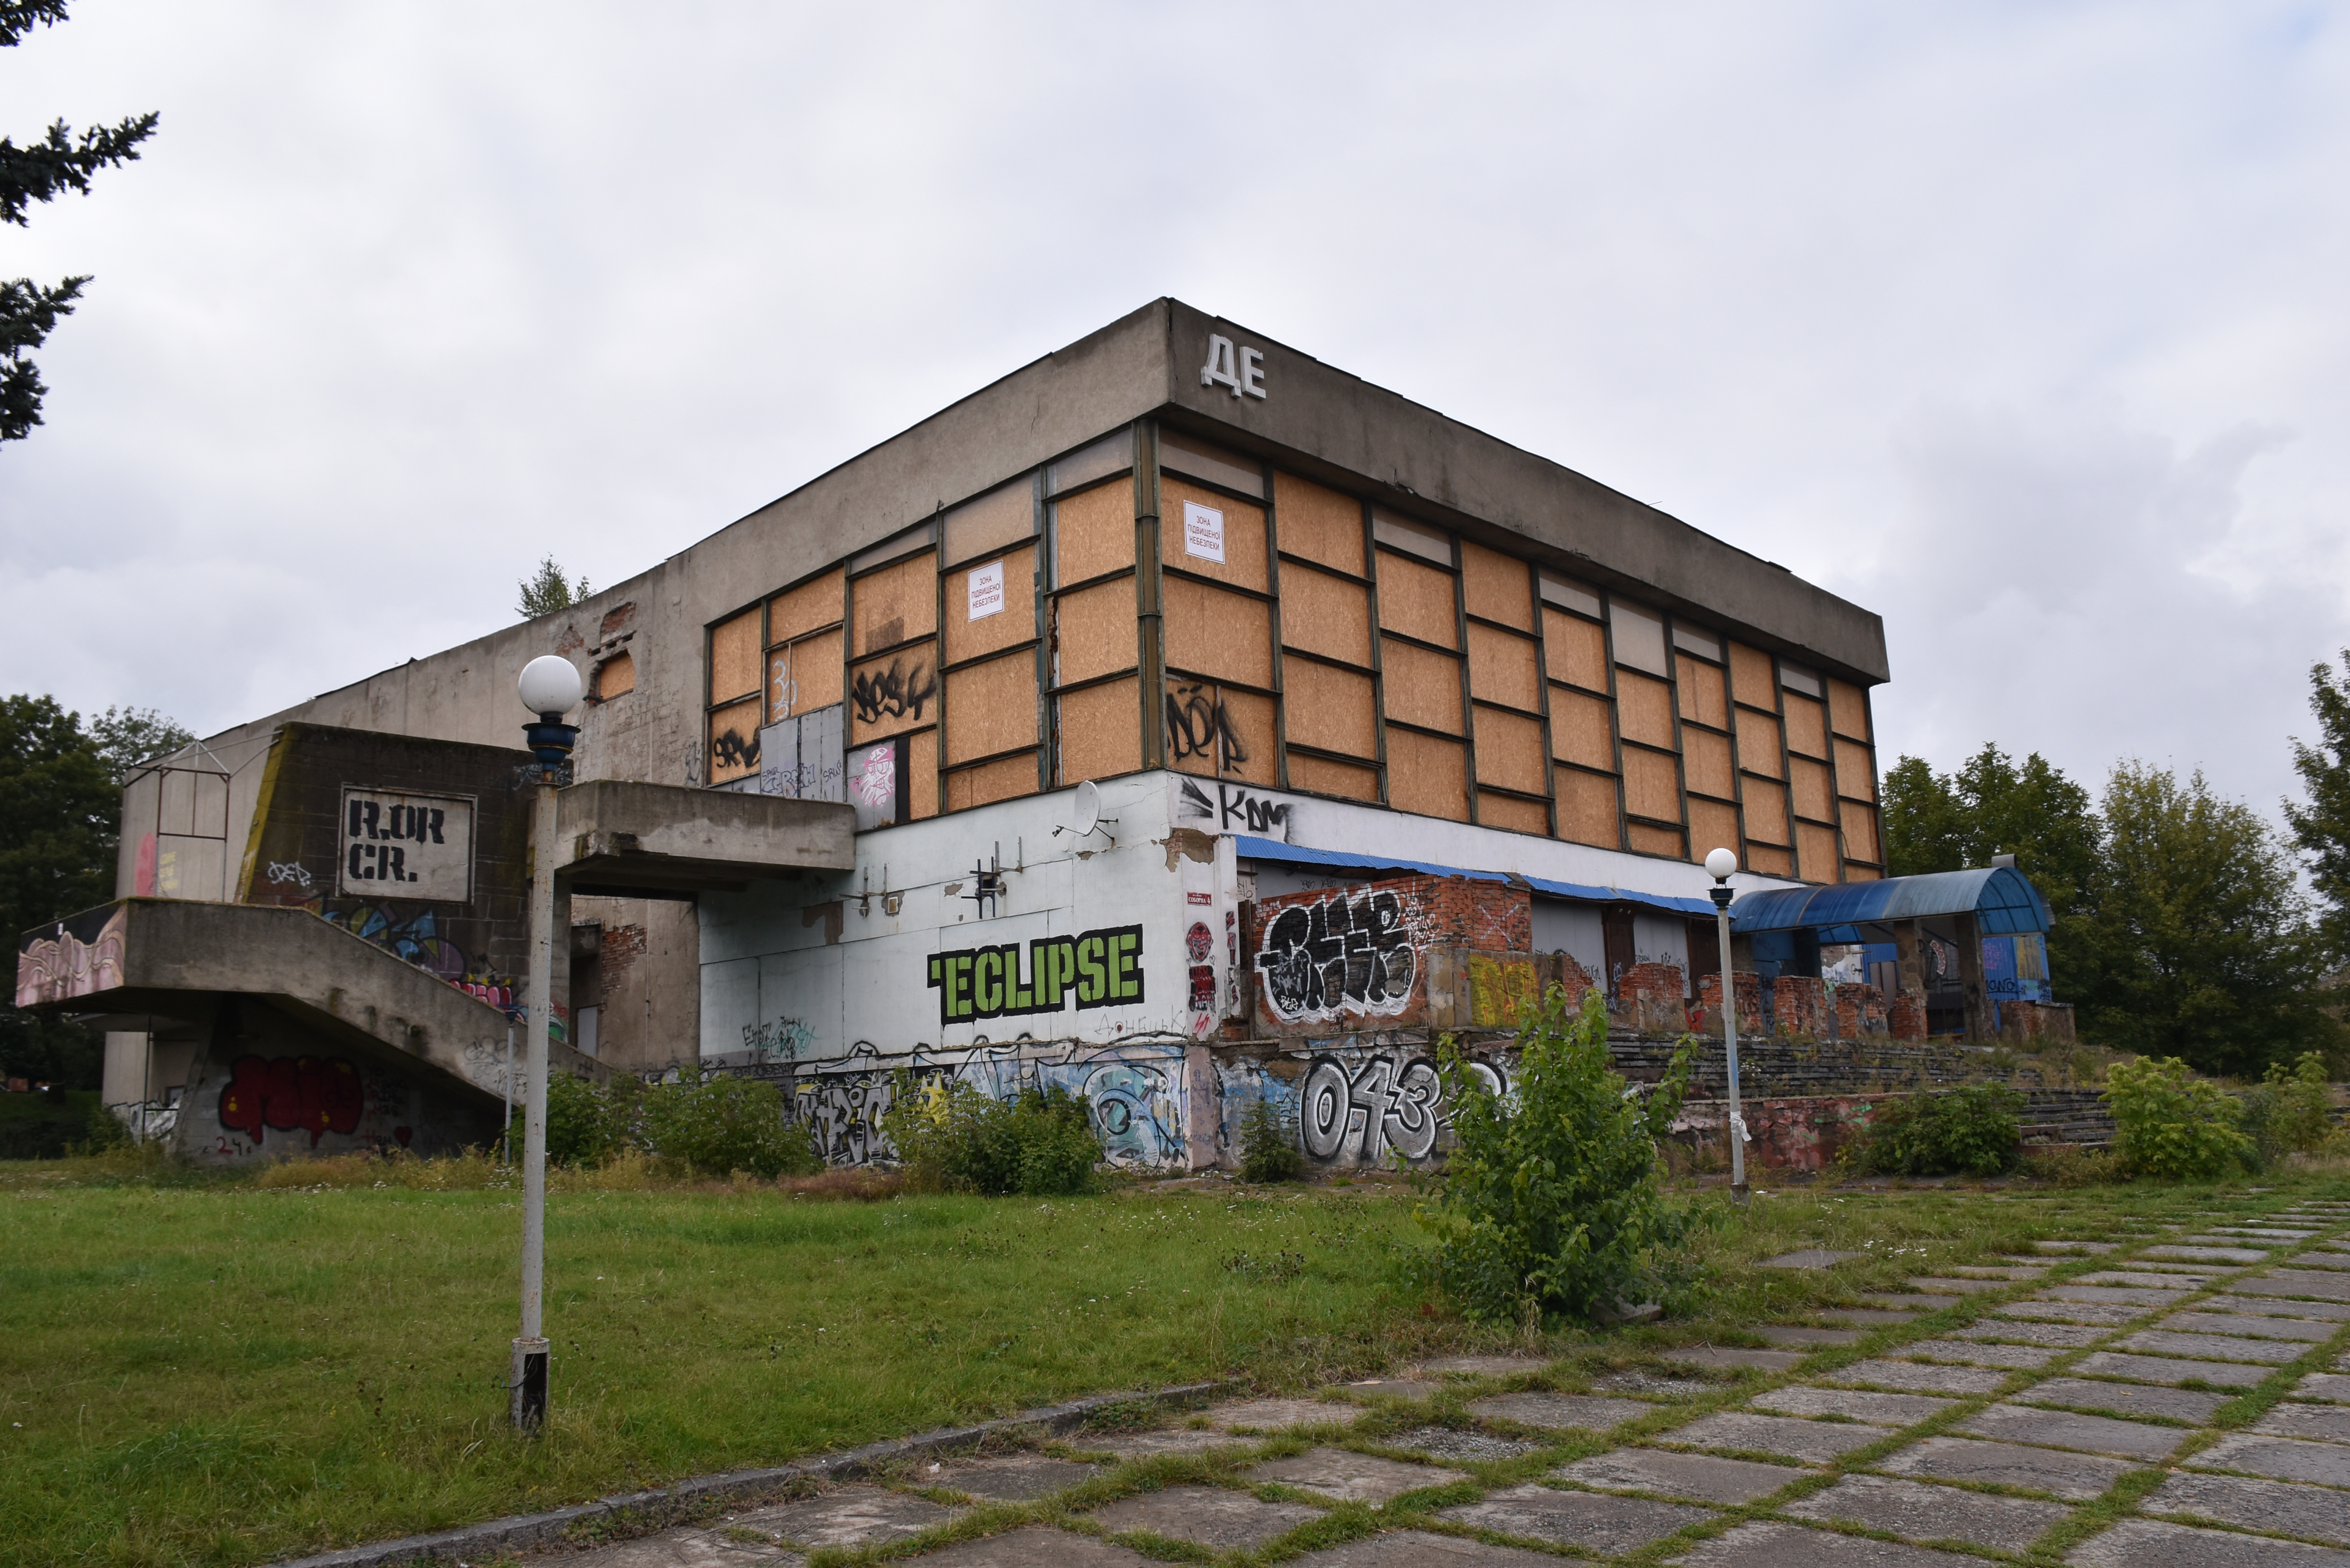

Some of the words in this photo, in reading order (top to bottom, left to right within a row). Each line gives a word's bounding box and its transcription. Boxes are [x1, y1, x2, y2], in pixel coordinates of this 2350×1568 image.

[1201, 333, 1266, 400] ДЕ
[1196, 516, 1211, 526] ЗОНА
[1188, 524, 1220, 540] ПІДВИЩЕНОЇ
[1189, 535, 1219, 551] НЕБЕЗПЕКИ
[980, 575, 992, 585] ЗОНА
[971, 581, 1001, 599] ПІДВИЩЕНОЇ
[973, 594, 1000, 609] НЕБЕЗПЕКИ
[927, 924, 1144, 1024] ECLIPSE
